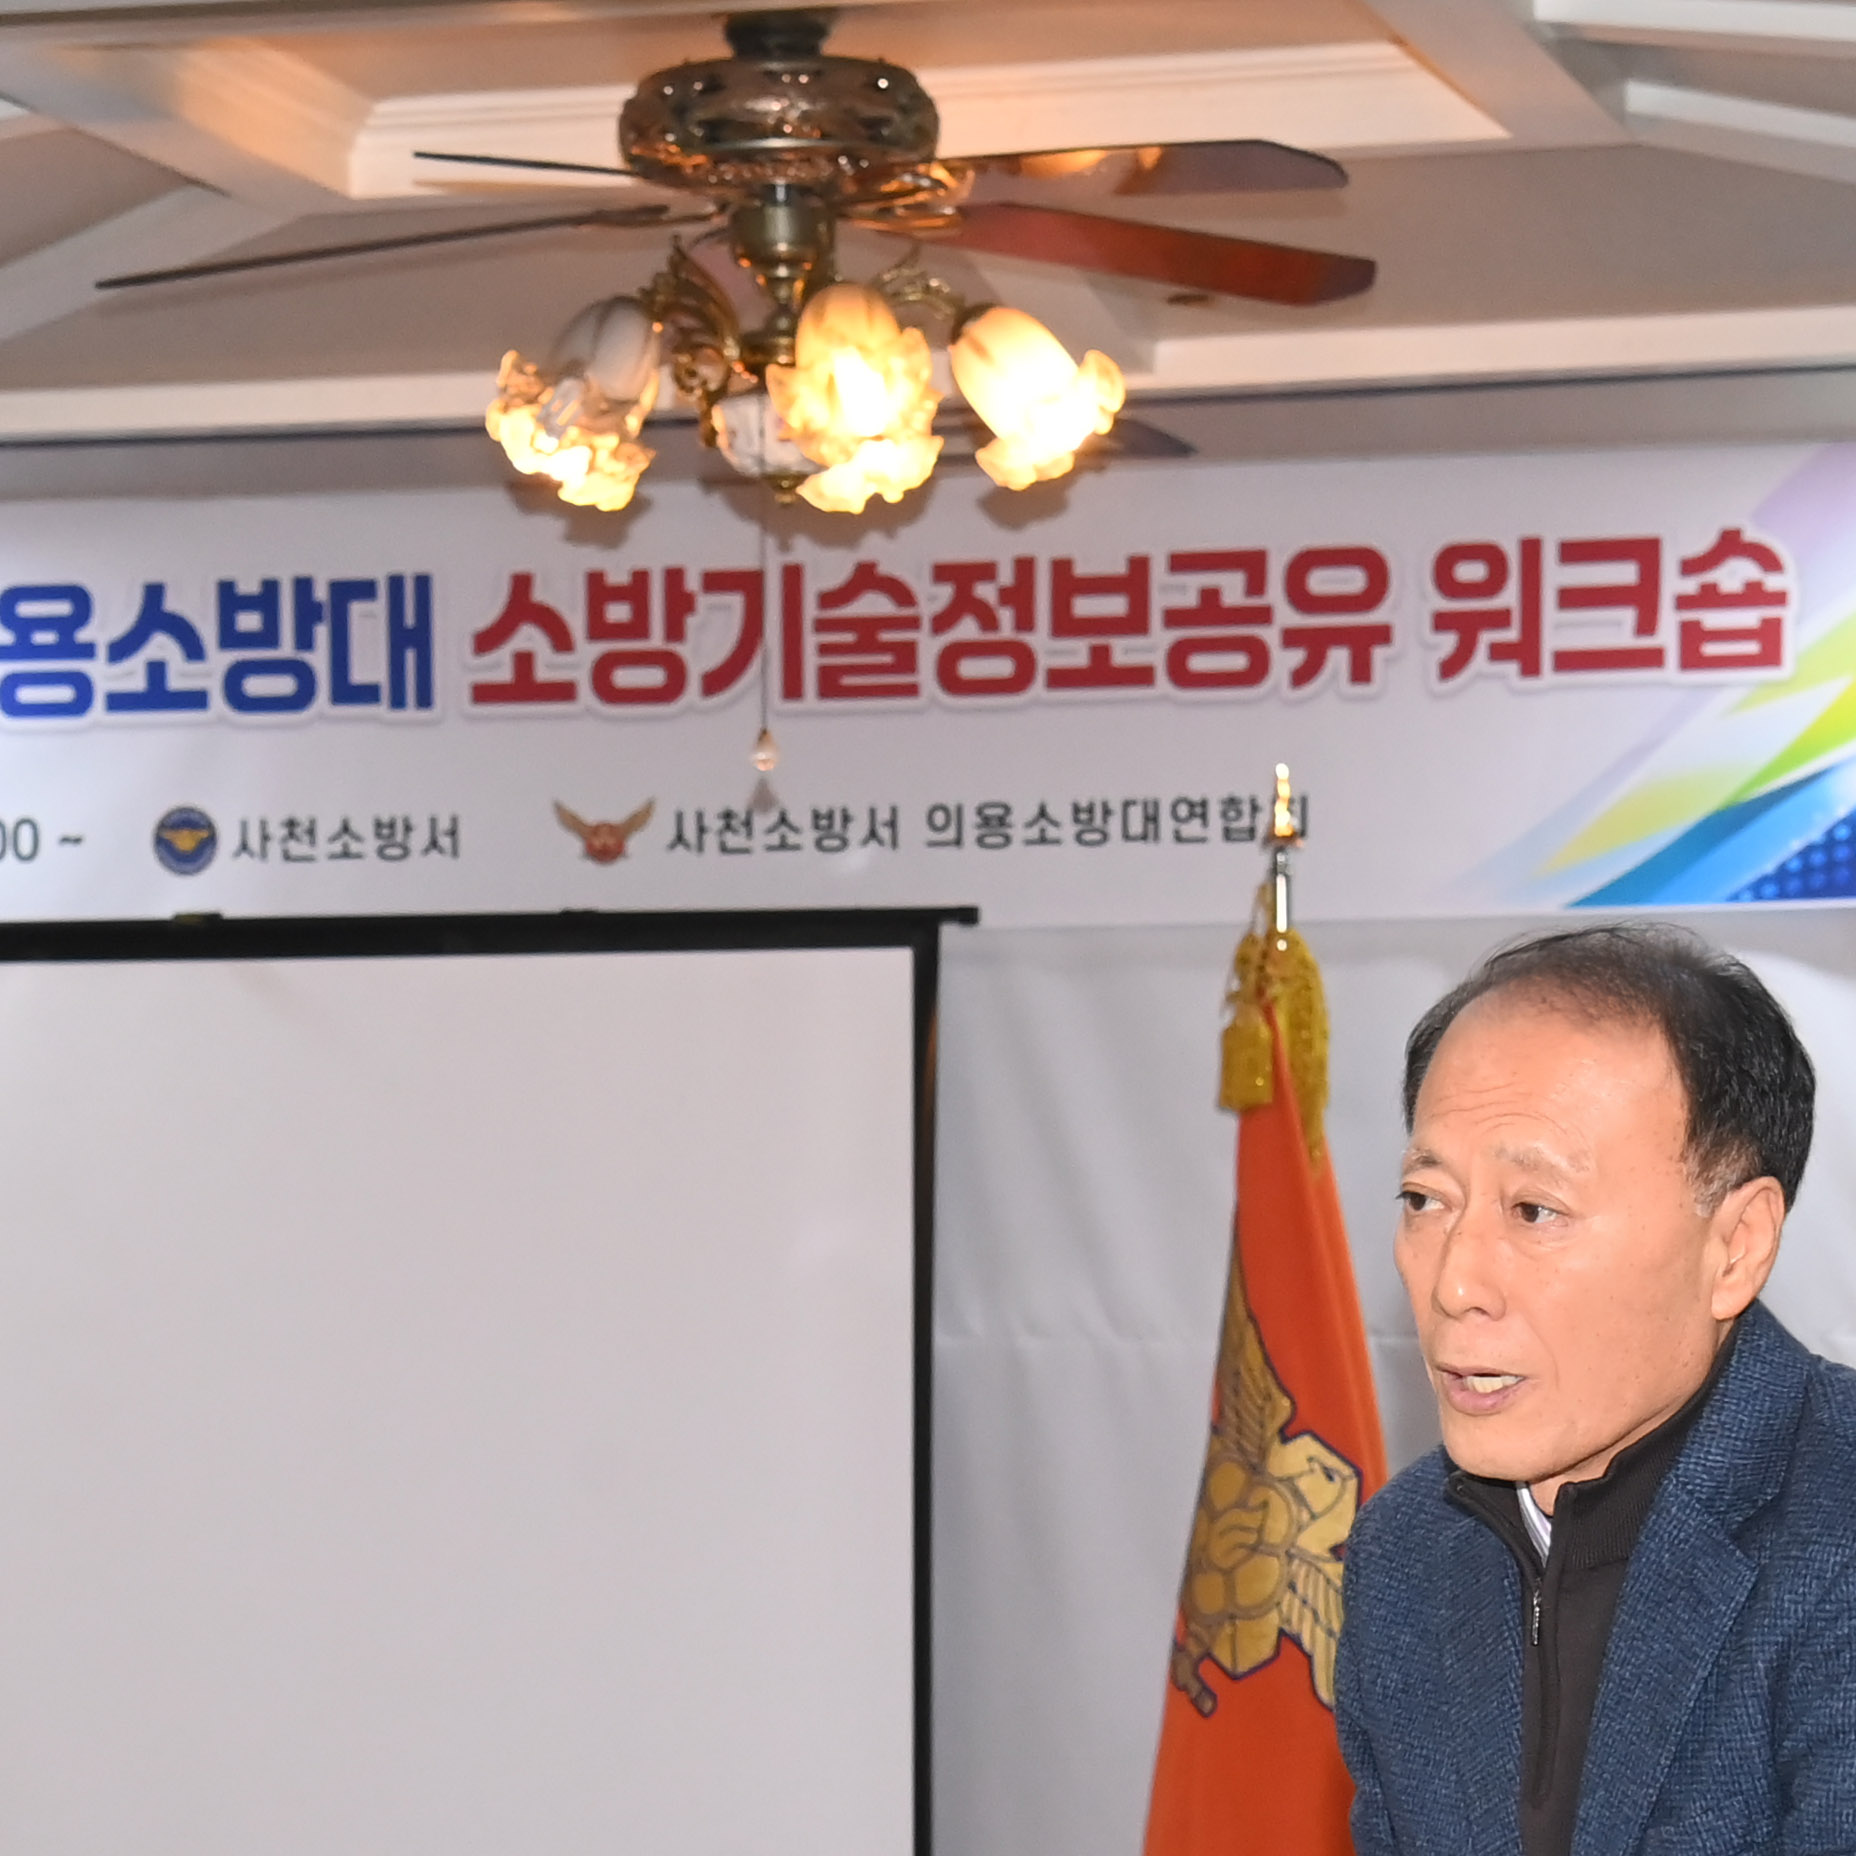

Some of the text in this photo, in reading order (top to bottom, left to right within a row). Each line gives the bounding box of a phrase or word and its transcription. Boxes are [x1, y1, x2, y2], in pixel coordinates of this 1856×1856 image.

[469, 545, 1394, 708] 소방기술정보공유
[1430, 527, 1791, 684] 워크숍
[233, 813, 461, 863] 사천소방서
[666, 803, 901, 856] 사천소방서
